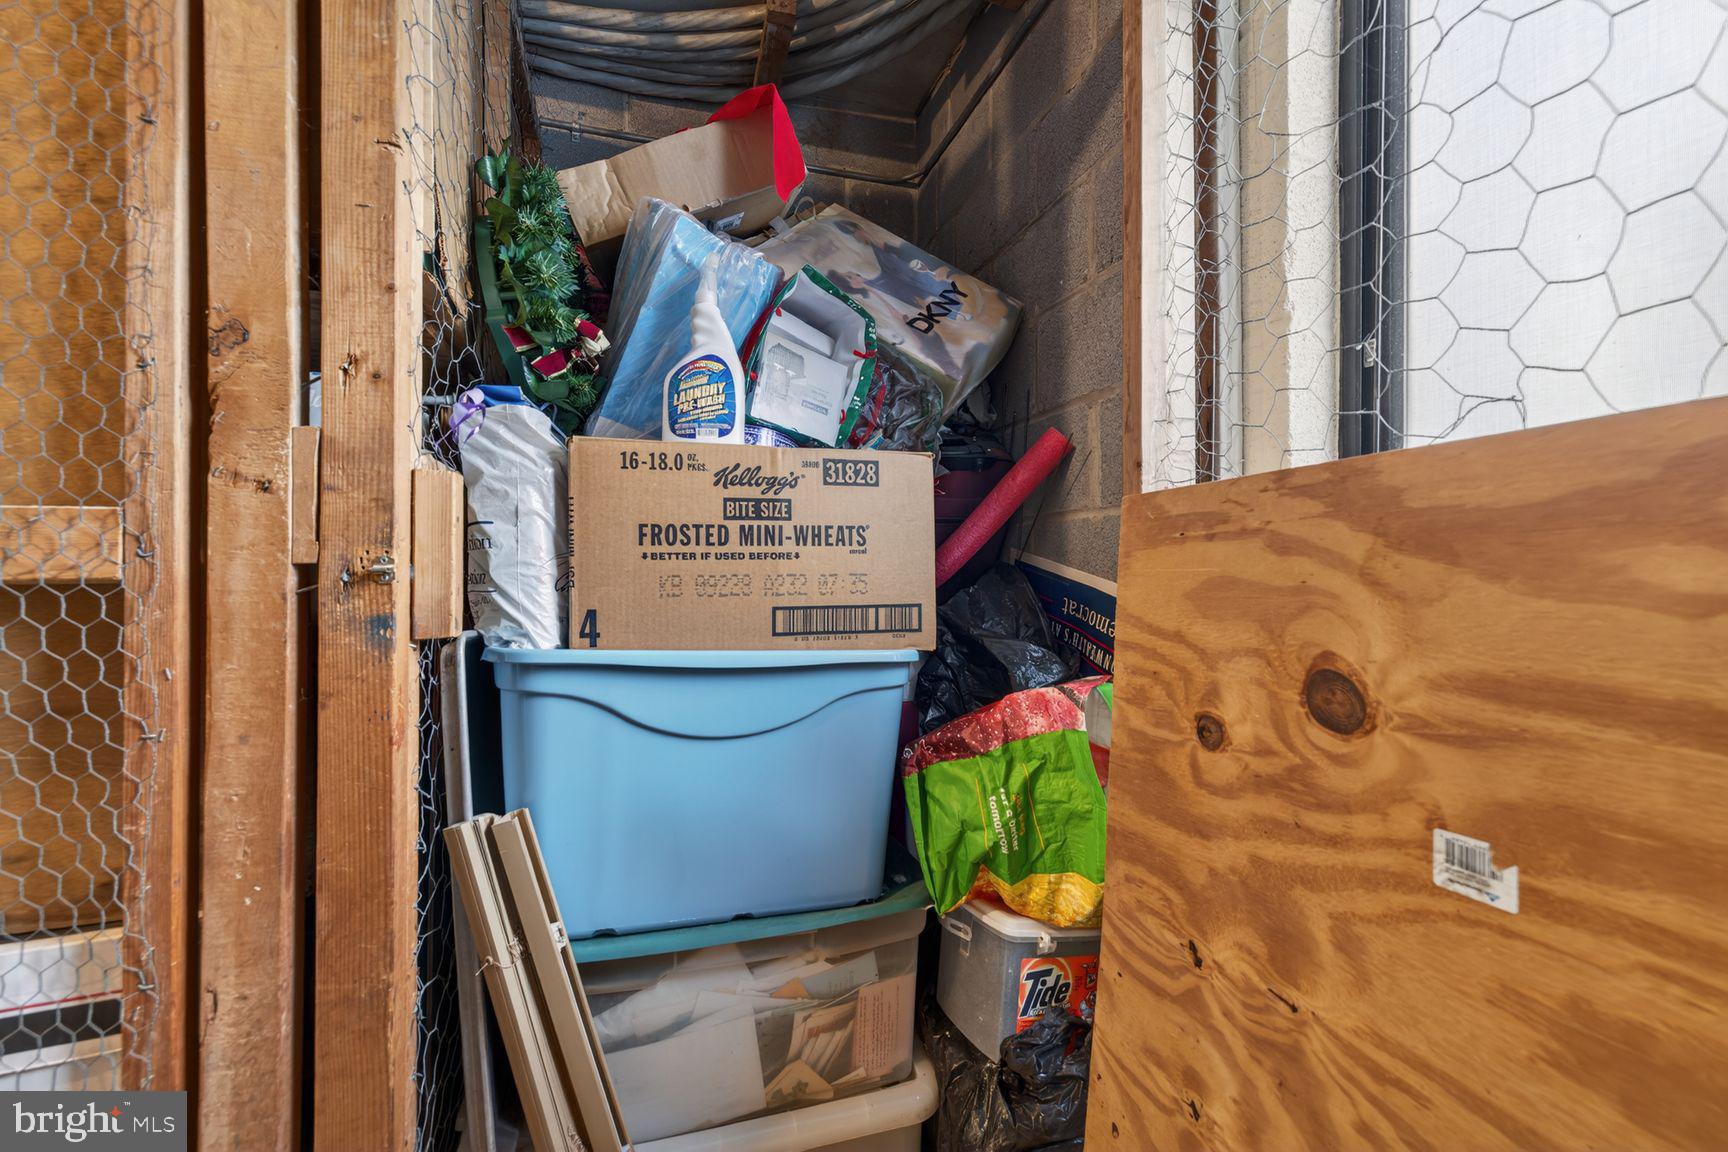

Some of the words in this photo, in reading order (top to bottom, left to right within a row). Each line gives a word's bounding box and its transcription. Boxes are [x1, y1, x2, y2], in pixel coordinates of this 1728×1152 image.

[906, 280, 968, 334] DKNY
[673, 381, 727, 406] LAUNDRY
[620, 451, 684, 471] 16-18.0
[825, 461, 877, 484] 31828
[713, 462, 800, 495] Kellogg's
[726, 501, 756, 518] BITE
[760, 501, 789, 518] SIZE
[638, 523, 729, 547] FROSTED
[650, 552, 697, 561] BETTER
[700, 552, 711, 561] IF
[714, 552, 745, 561] USED
[748, 552, 793, 561] BEFORE
[579, 609, 601, 648] 4
[1061, 597, 1116, 638] emocrat
[989, 795, 1010, 854] tomorrow
[1020, 967, 1071, 1018] Tide
